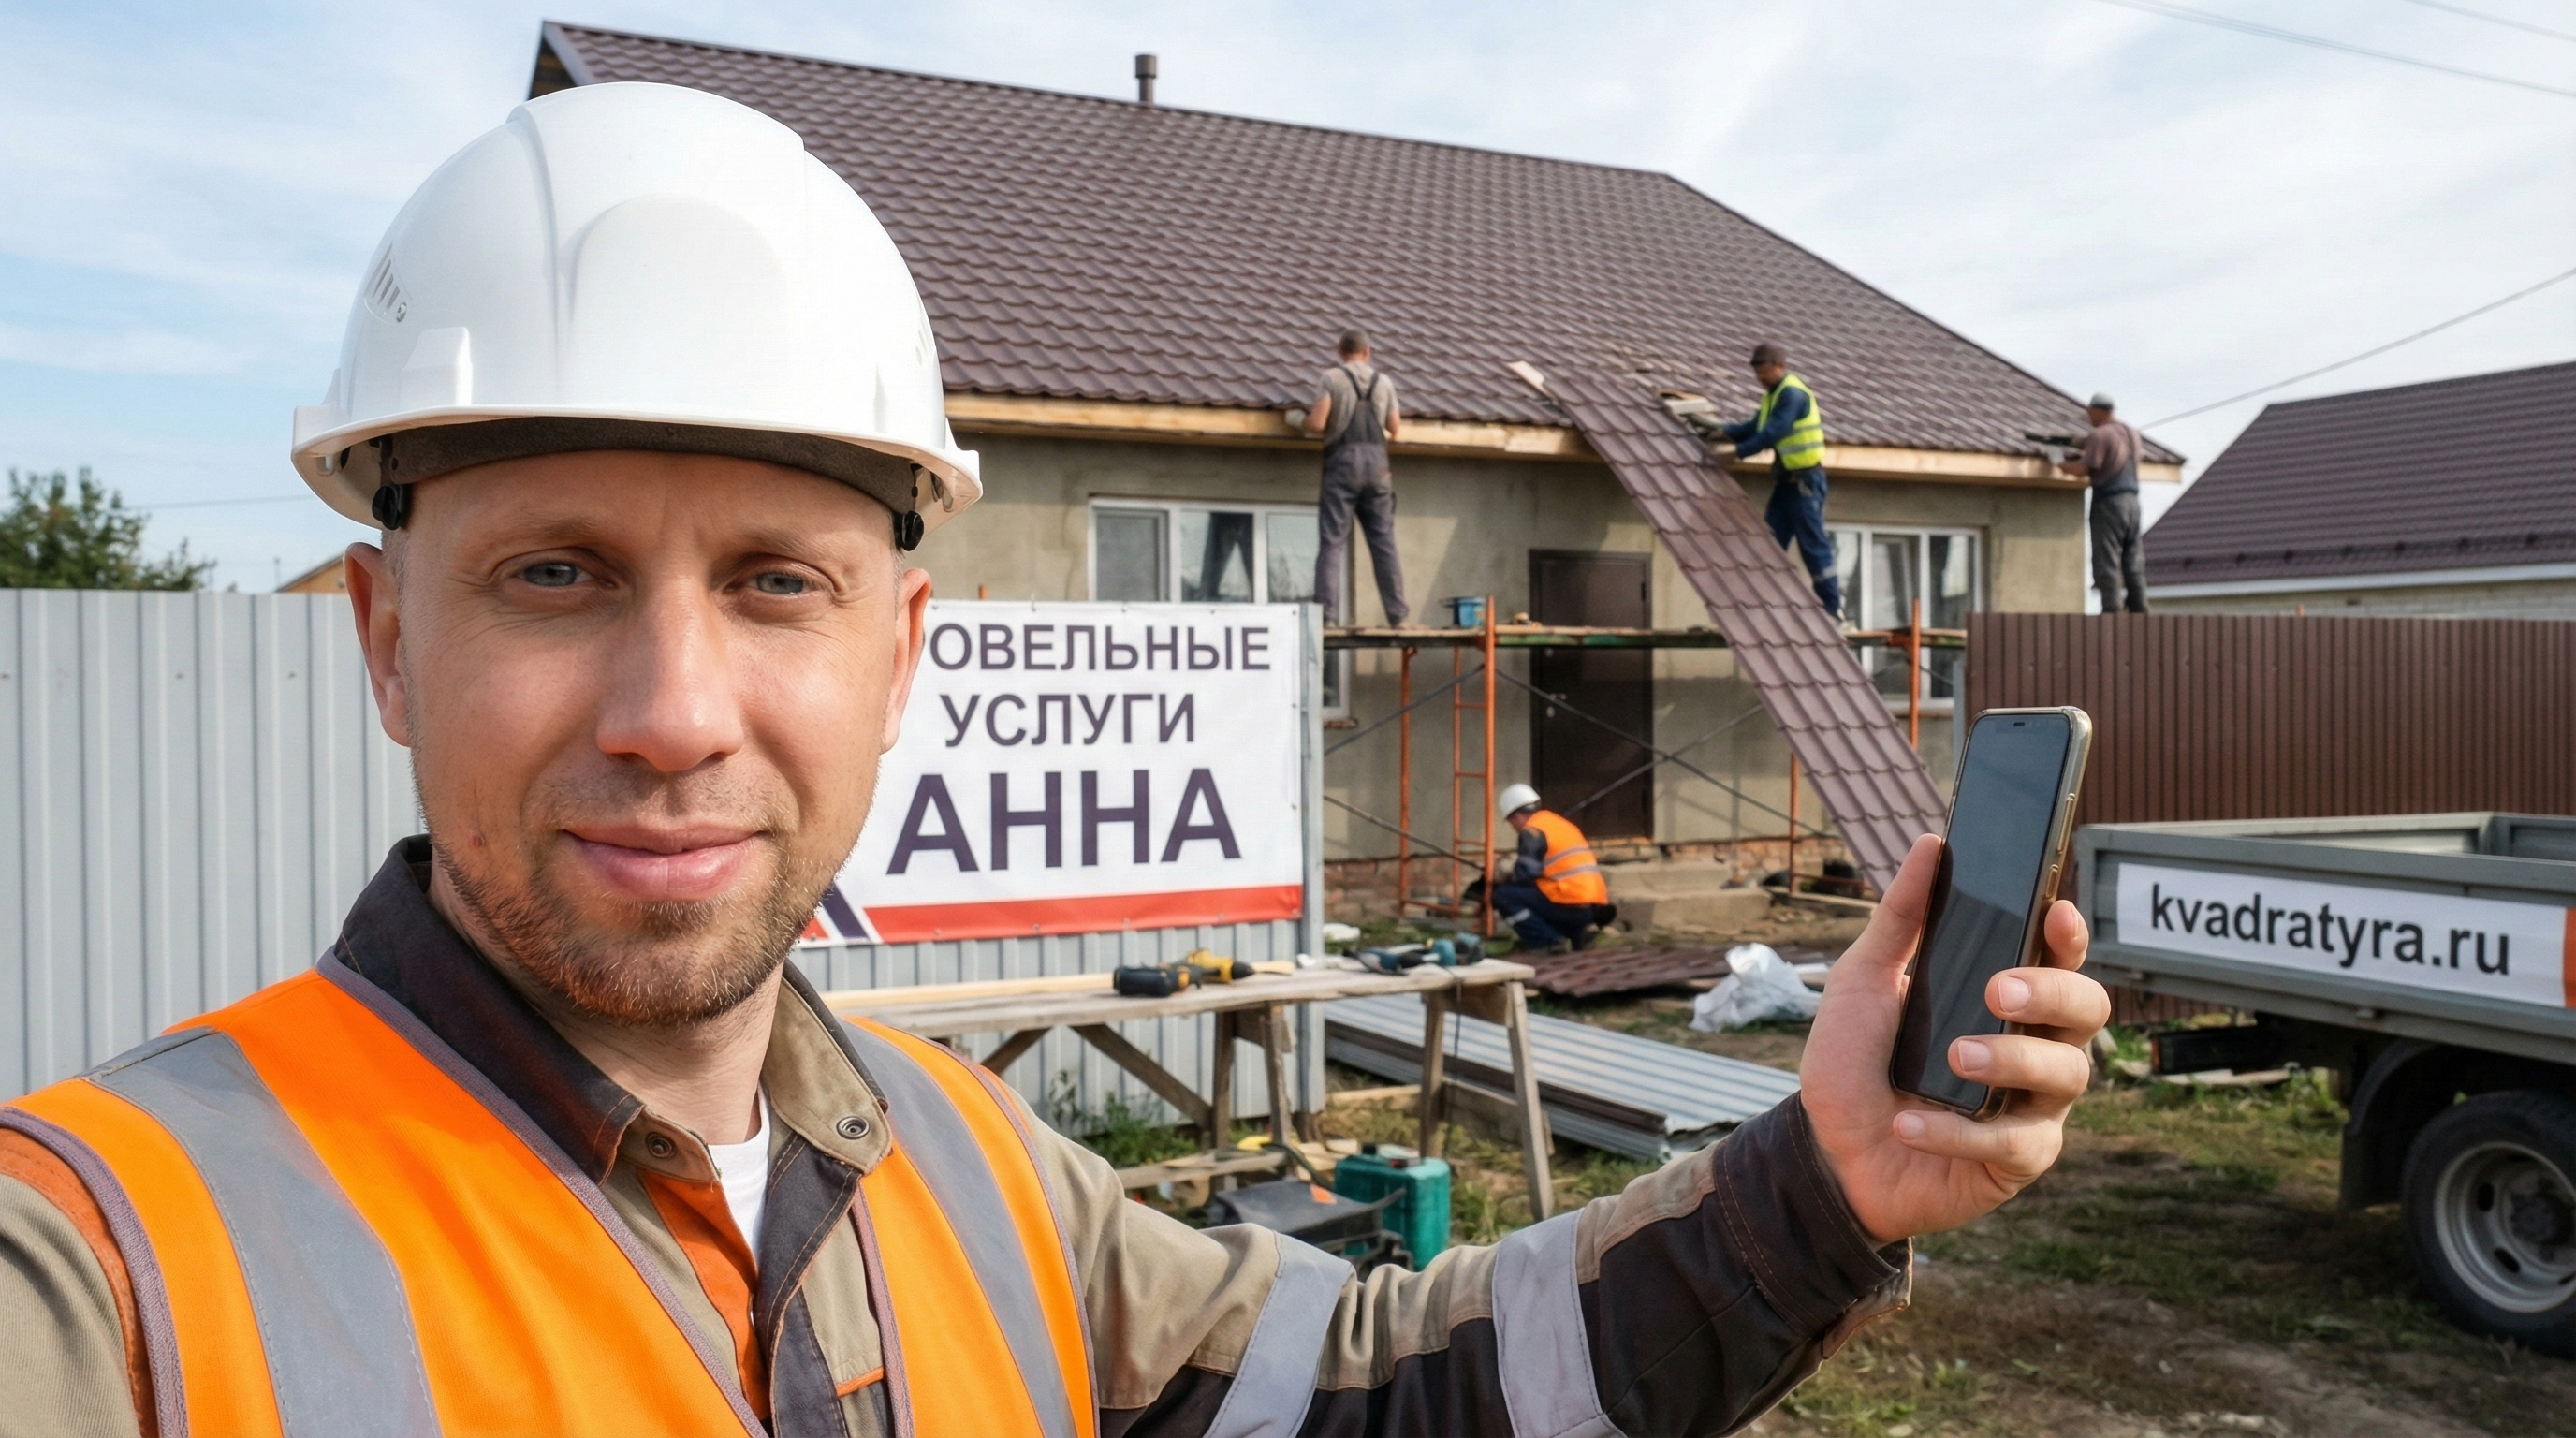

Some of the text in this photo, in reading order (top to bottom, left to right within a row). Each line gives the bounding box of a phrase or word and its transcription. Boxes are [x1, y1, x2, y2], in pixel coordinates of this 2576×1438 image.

[922, 623, 1271, 670] ОВЕЛЬНЫЕ
[939, 693, 1194, 748] УСЛУГИ
[886, 768, 1241, 875] АННА
[2151, 883, 2510, 976] kvadratyra.ru
